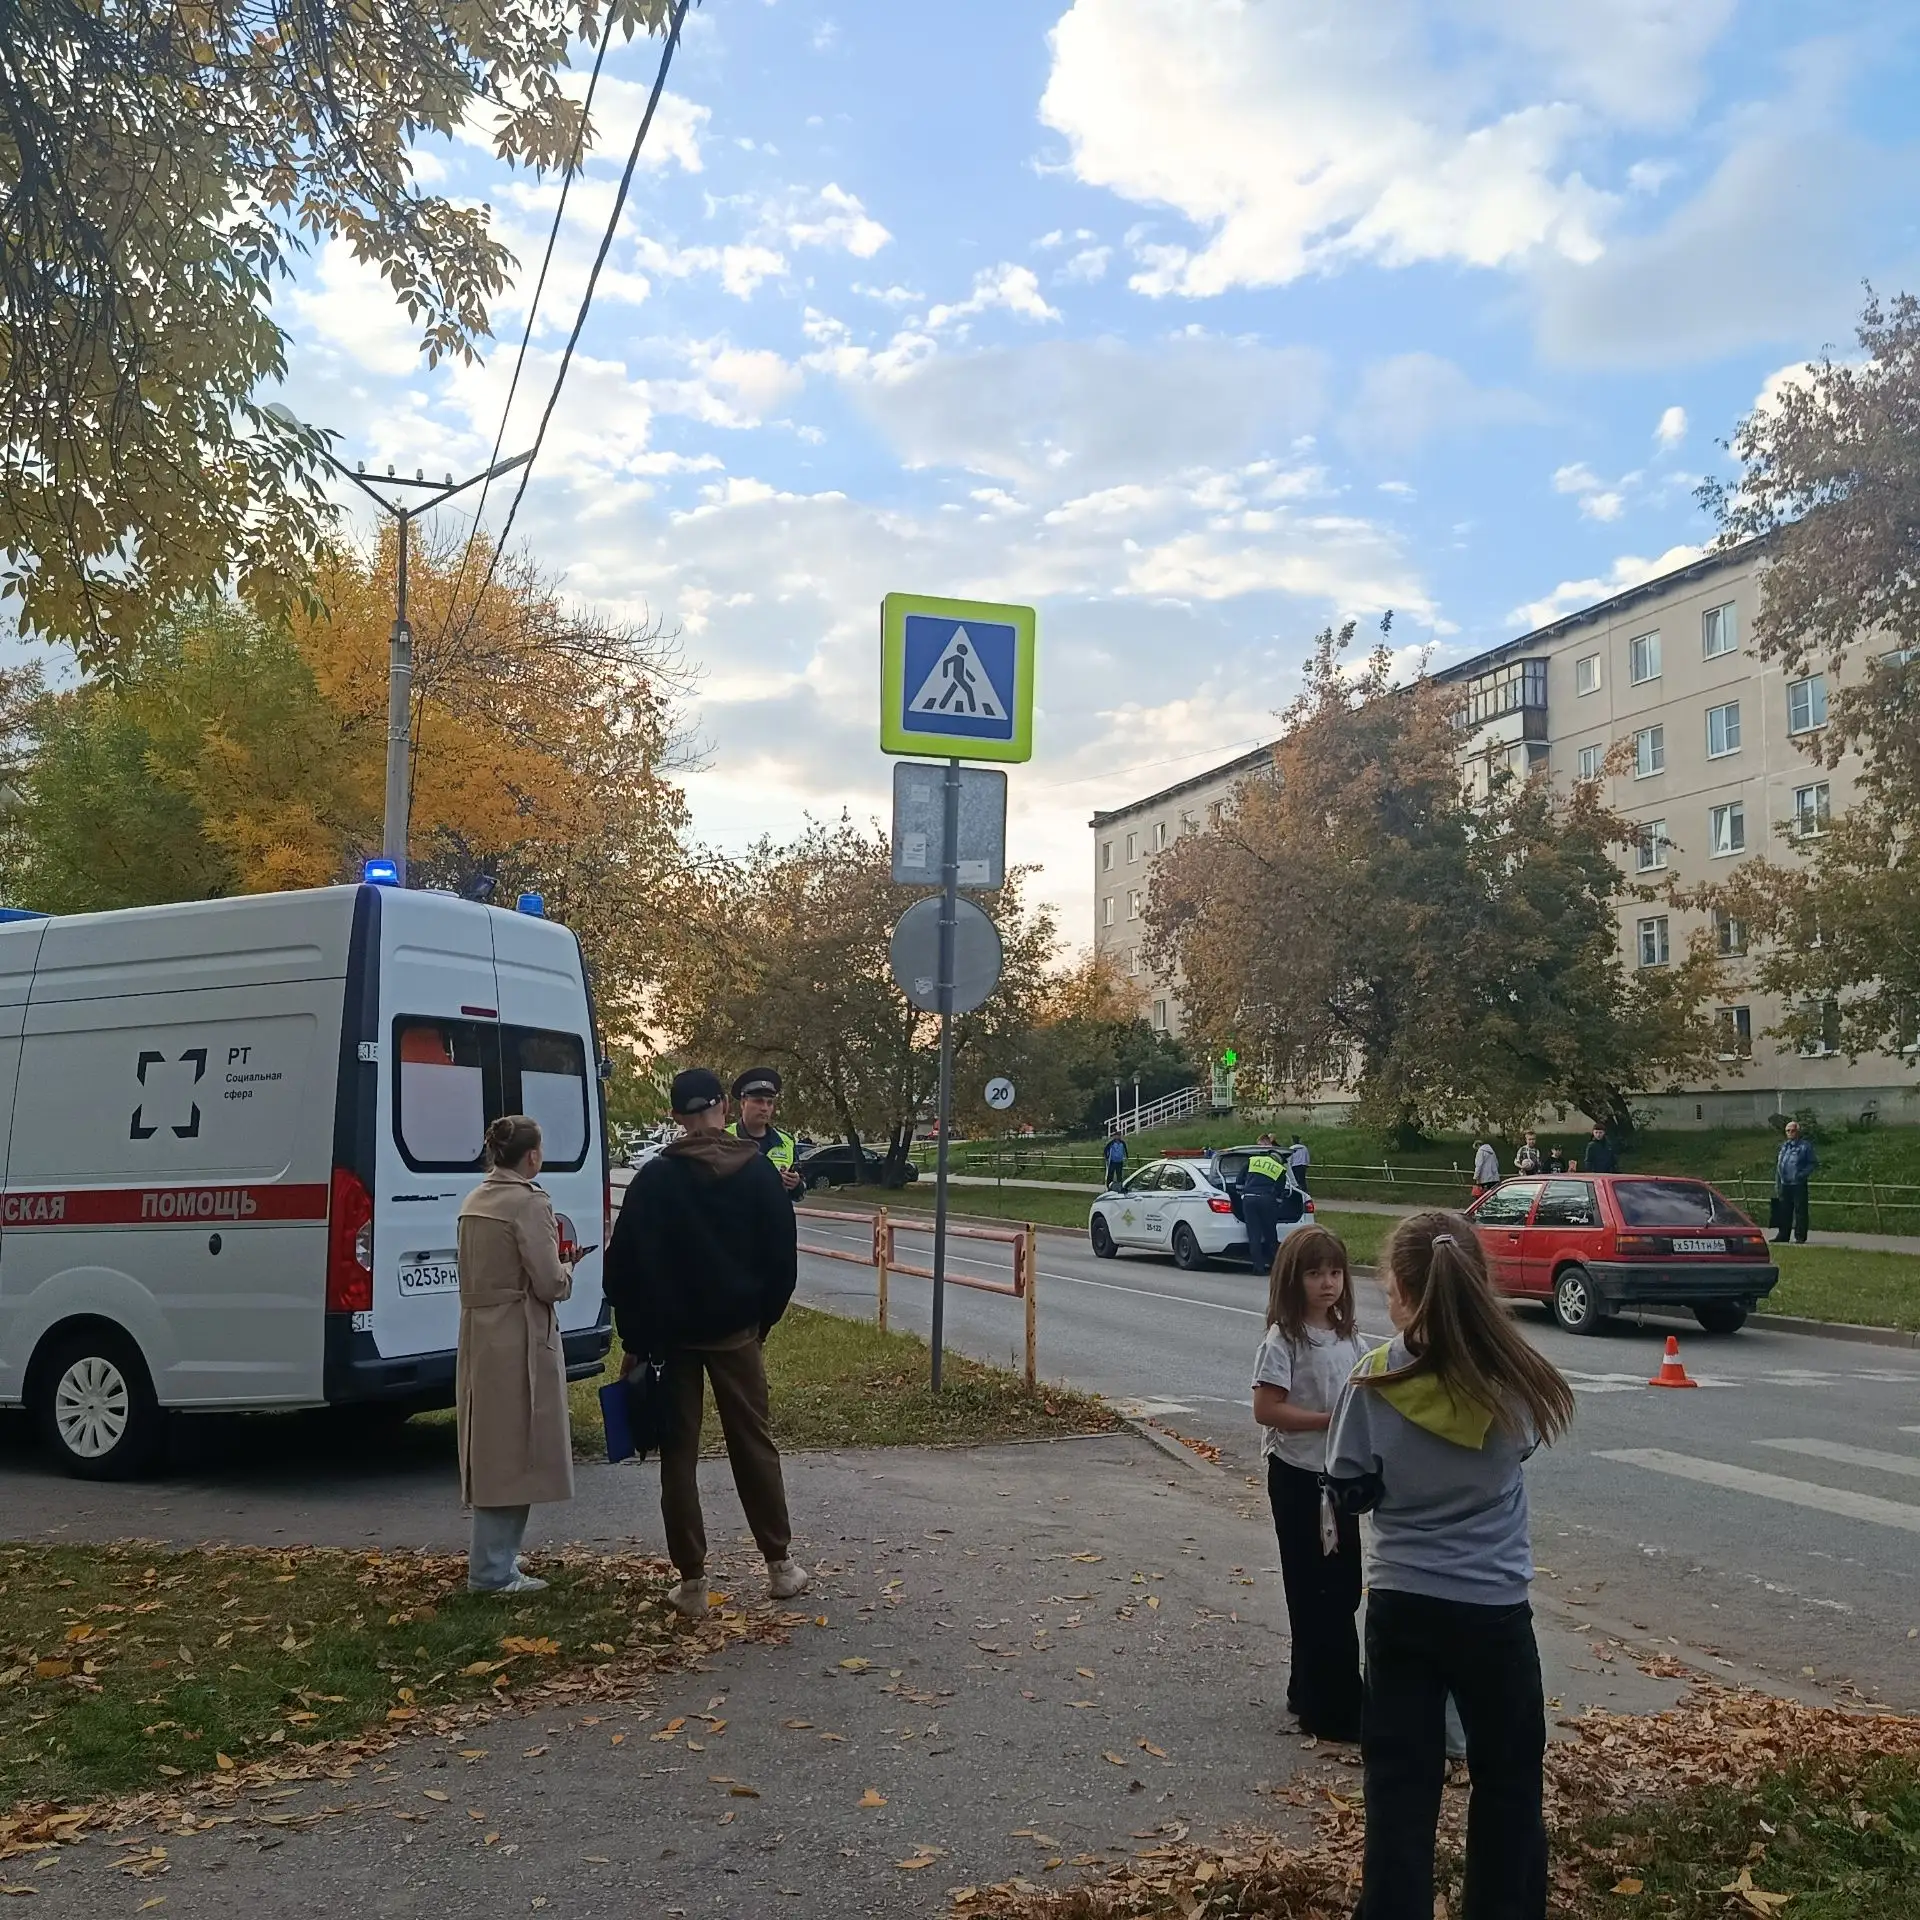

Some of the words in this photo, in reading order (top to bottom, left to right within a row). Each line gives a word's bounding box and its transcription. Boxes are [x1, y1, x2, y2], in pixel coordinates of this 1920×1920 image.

[228, 1046, 252, 1065] РТ
[225, 1073, 282, 1083] Социальная
[224, 1089, 253, 1101] сфера
[991, 1087, 1009, 1101] 20
[1252, 1159, 1279, 1175] ДПС
[140, 1190, 257, 1220] ПОМОЩЬ
